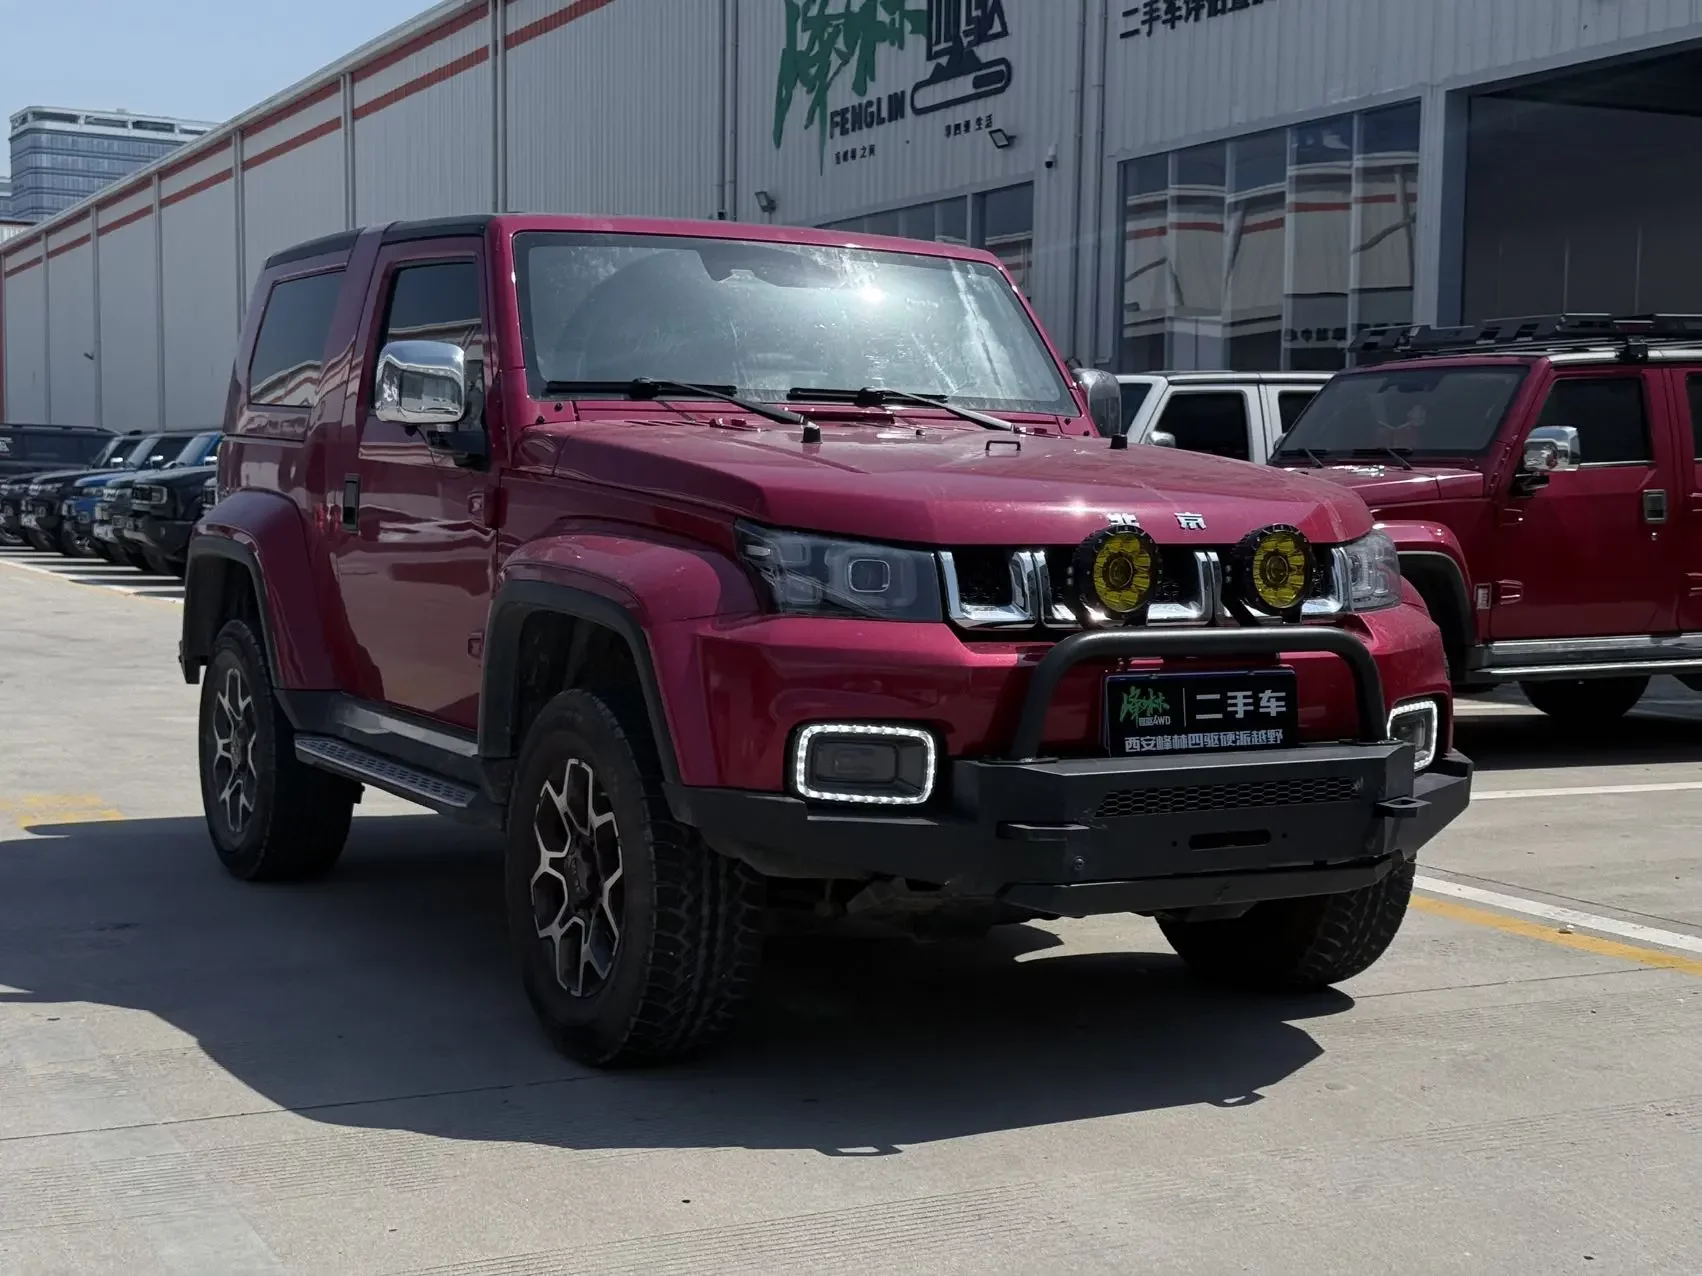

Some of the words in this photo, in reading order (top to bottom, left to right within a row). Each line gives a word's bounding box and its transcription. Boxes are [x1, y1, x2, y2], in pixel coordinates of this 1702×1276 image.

[830, 90, 906, 139] FENGLIN
[1195, 689, 1287, 719] 二手车
[1124, 728, 1284, 753] 西安峰林四驱硬派越野
